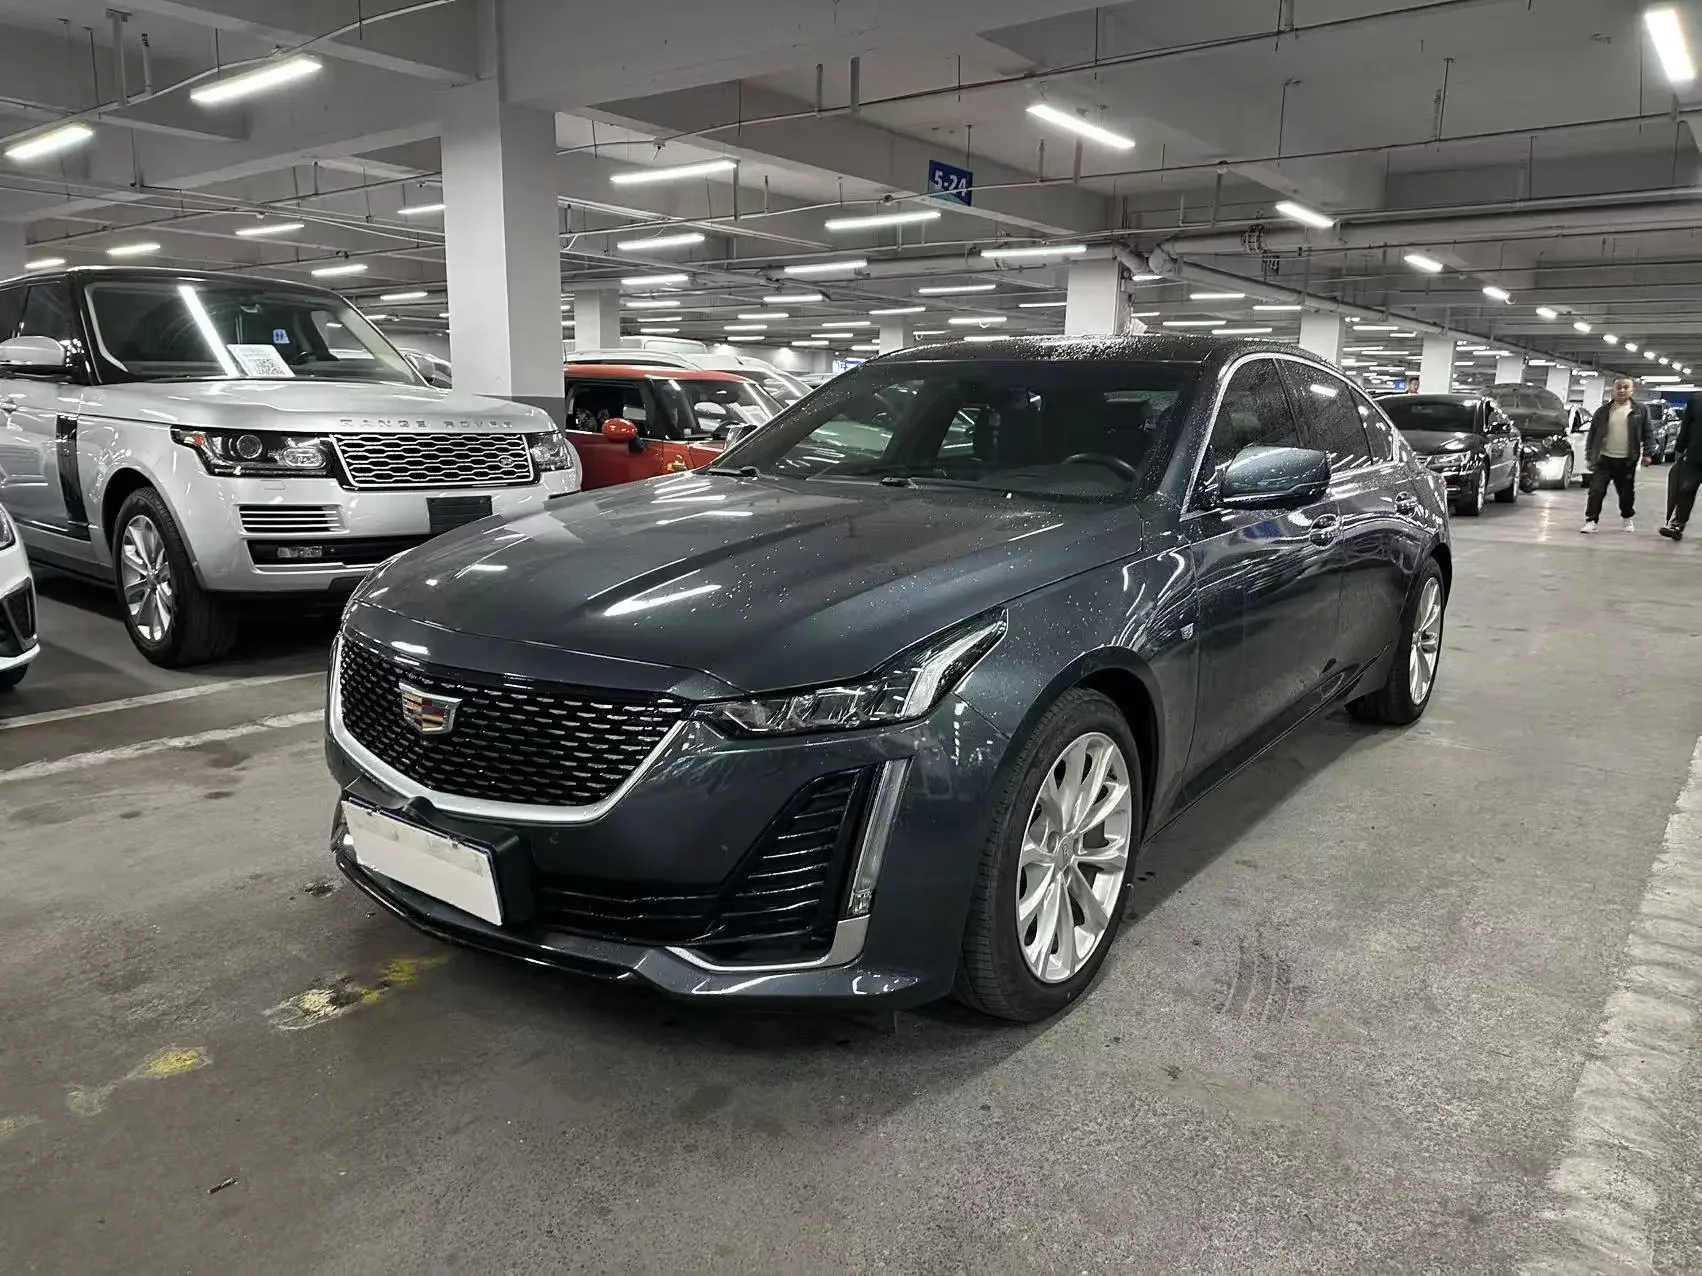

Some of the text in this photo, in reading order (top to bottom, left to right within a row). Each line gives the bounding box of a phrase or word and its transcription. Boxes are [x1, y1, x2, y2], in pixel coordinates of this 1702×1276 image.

[934, 169, 967, 197] 5-24
[340, 418, 513, 429] RANGE ROVER
